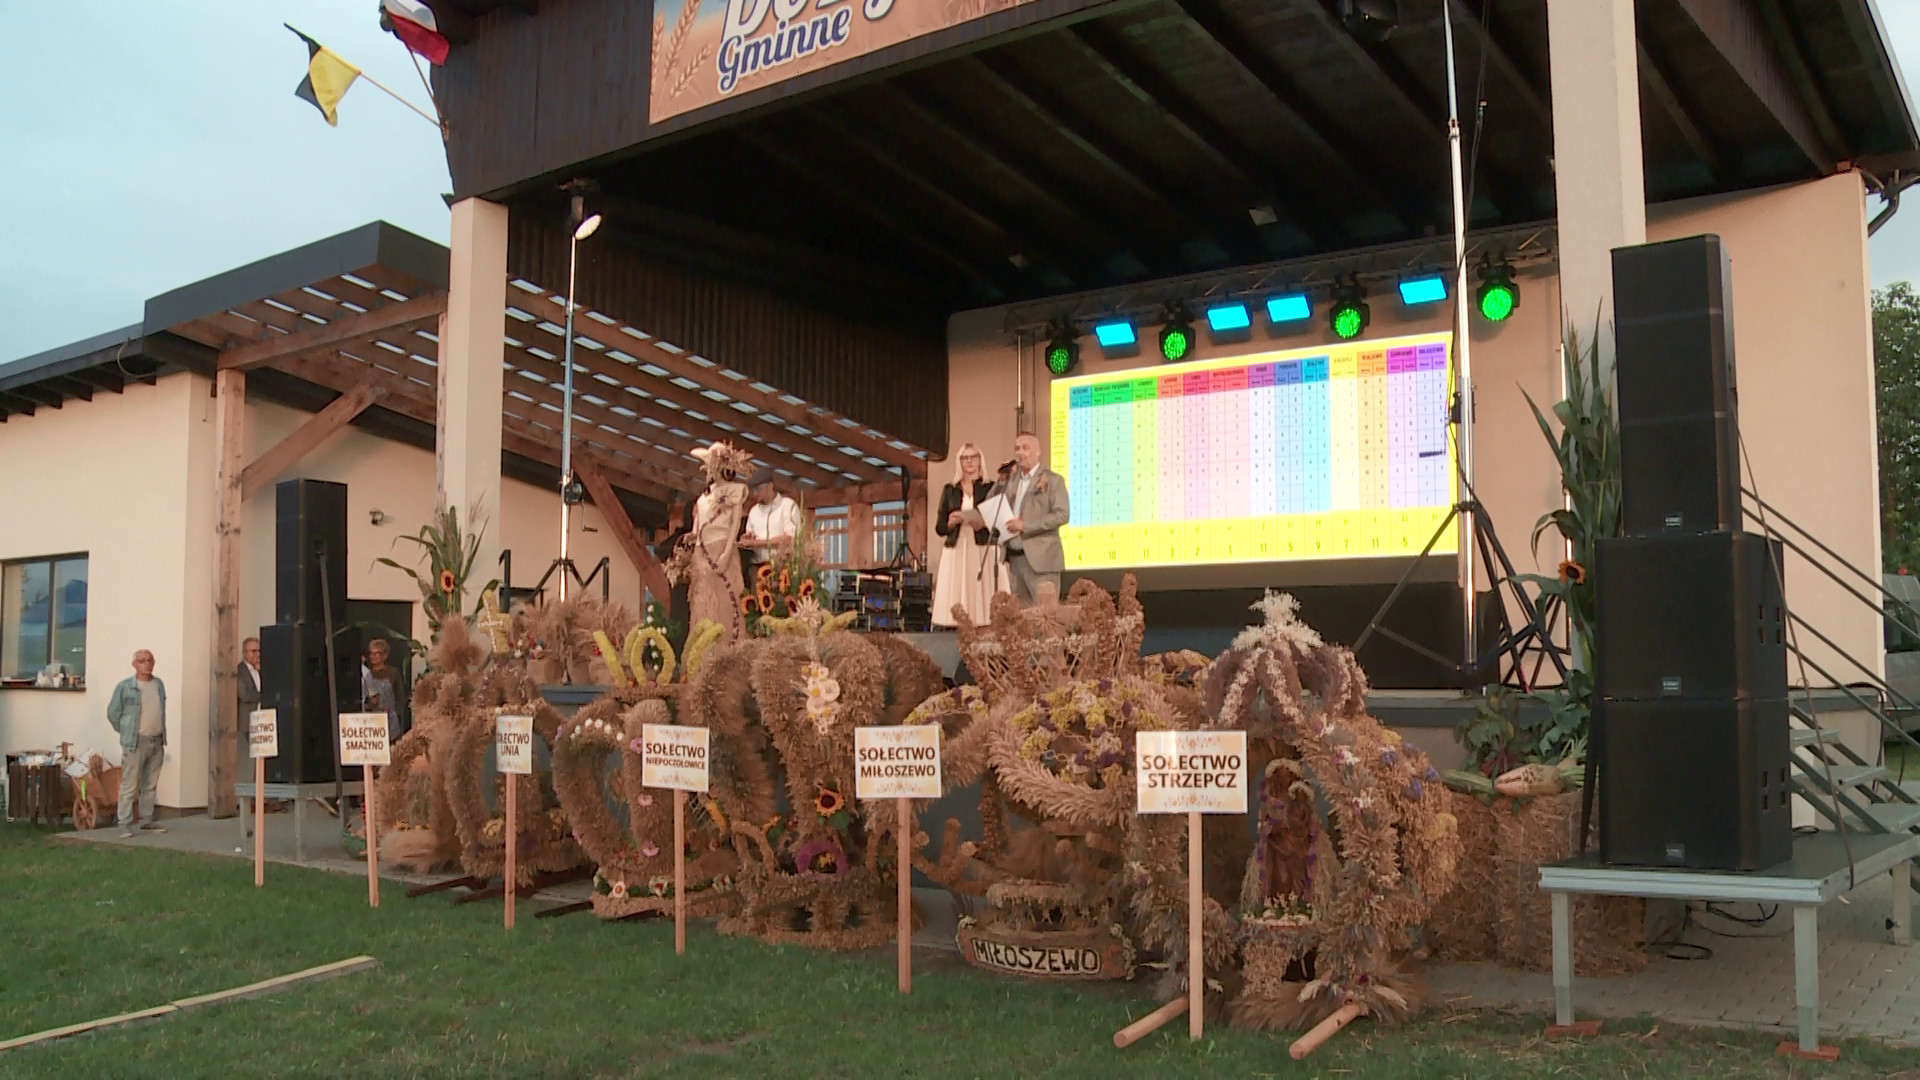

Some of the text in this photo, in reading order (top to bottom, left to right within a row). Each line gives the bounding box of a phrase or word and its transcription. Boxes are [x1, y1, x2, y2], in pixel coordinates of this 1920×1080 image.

[719, 9, 850, 91] Gminne
[342, 727, 386, 738] SOŁECTWO
[346, 739, 384, 750] SMAŻYNO
[645, 742, 706, 759] SOŁECTWO
[859, 747, 936, 761] SOŁECTWO
[1142, 755, 1241, 770] SOŁECTWO
[860, 765, 936, 778] MIŁOSZEWO
[1148, 773, 1237, 788] STRZEPCZ
[971, 938, 1099, 973] MIŁOSZEWO
